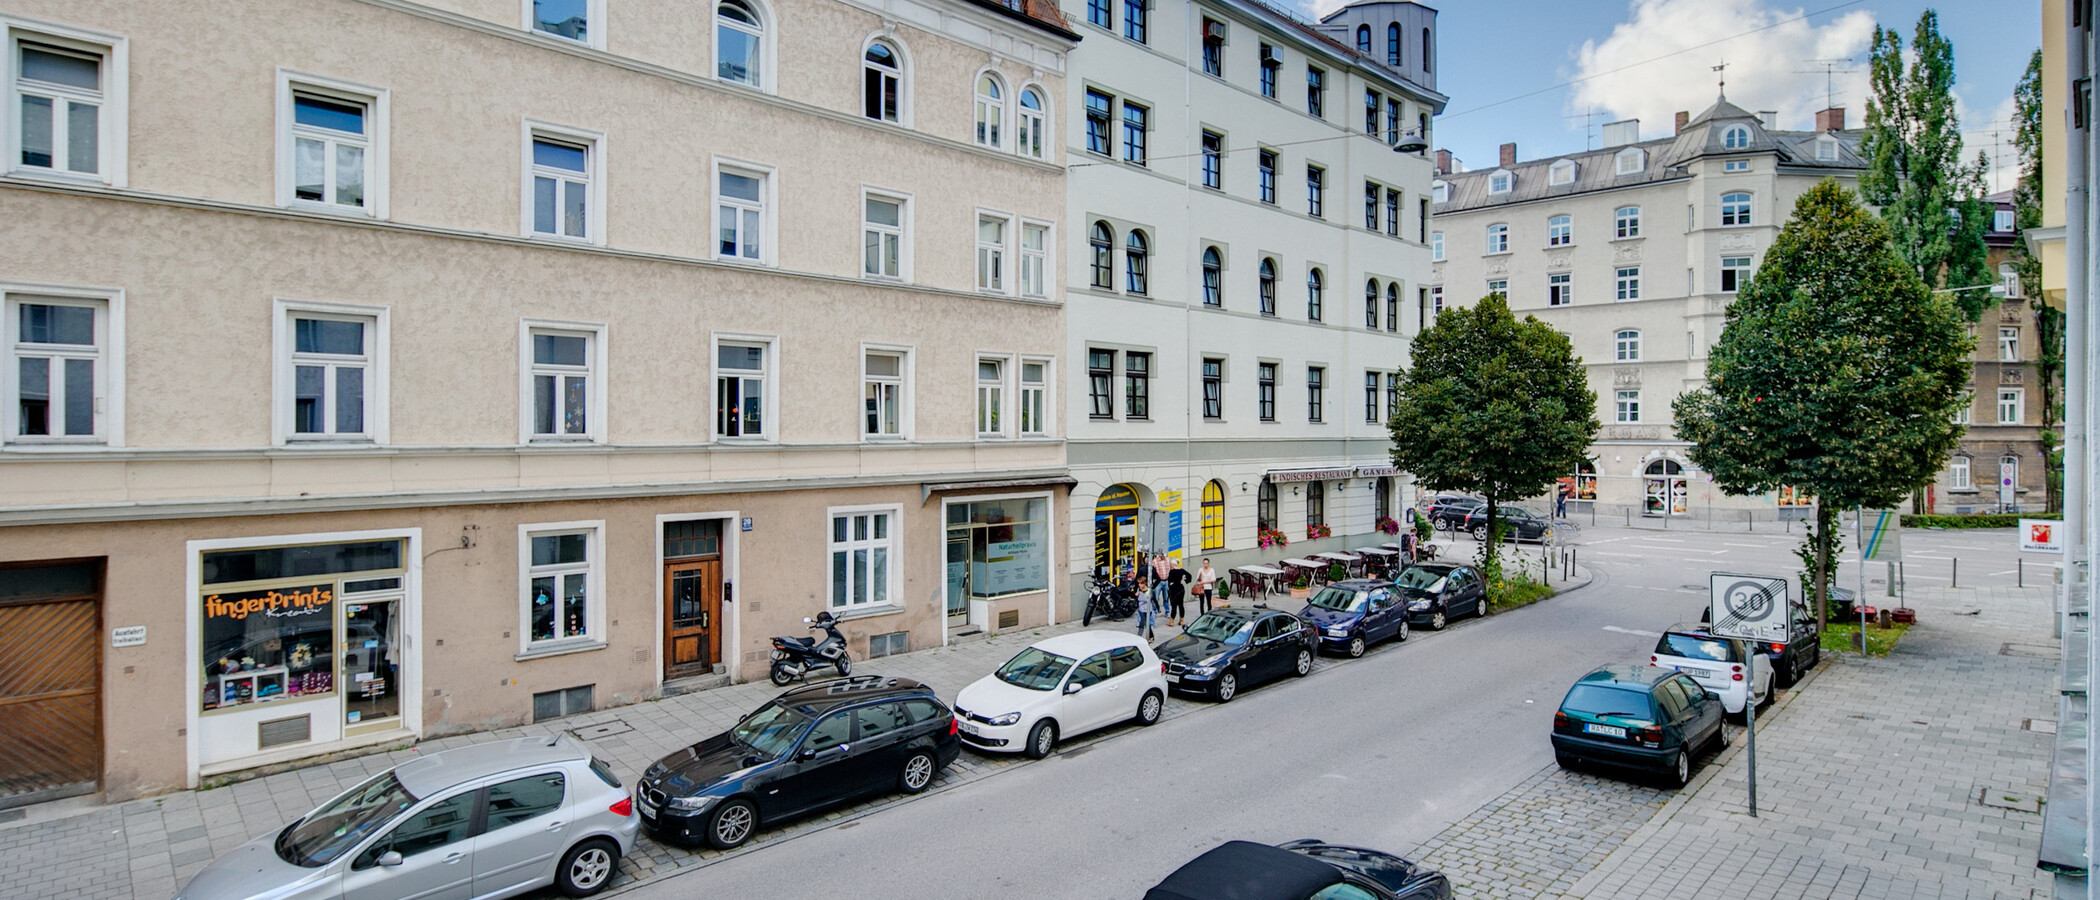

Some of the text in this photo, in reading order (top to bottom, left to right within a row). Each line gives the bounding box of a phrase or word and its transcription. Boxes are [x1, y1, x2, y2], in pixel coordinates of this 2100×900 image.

[1280, 470, 1351, 481] INDISCHES RESTAURANT
[1734, 592, 1763, 611] 30
